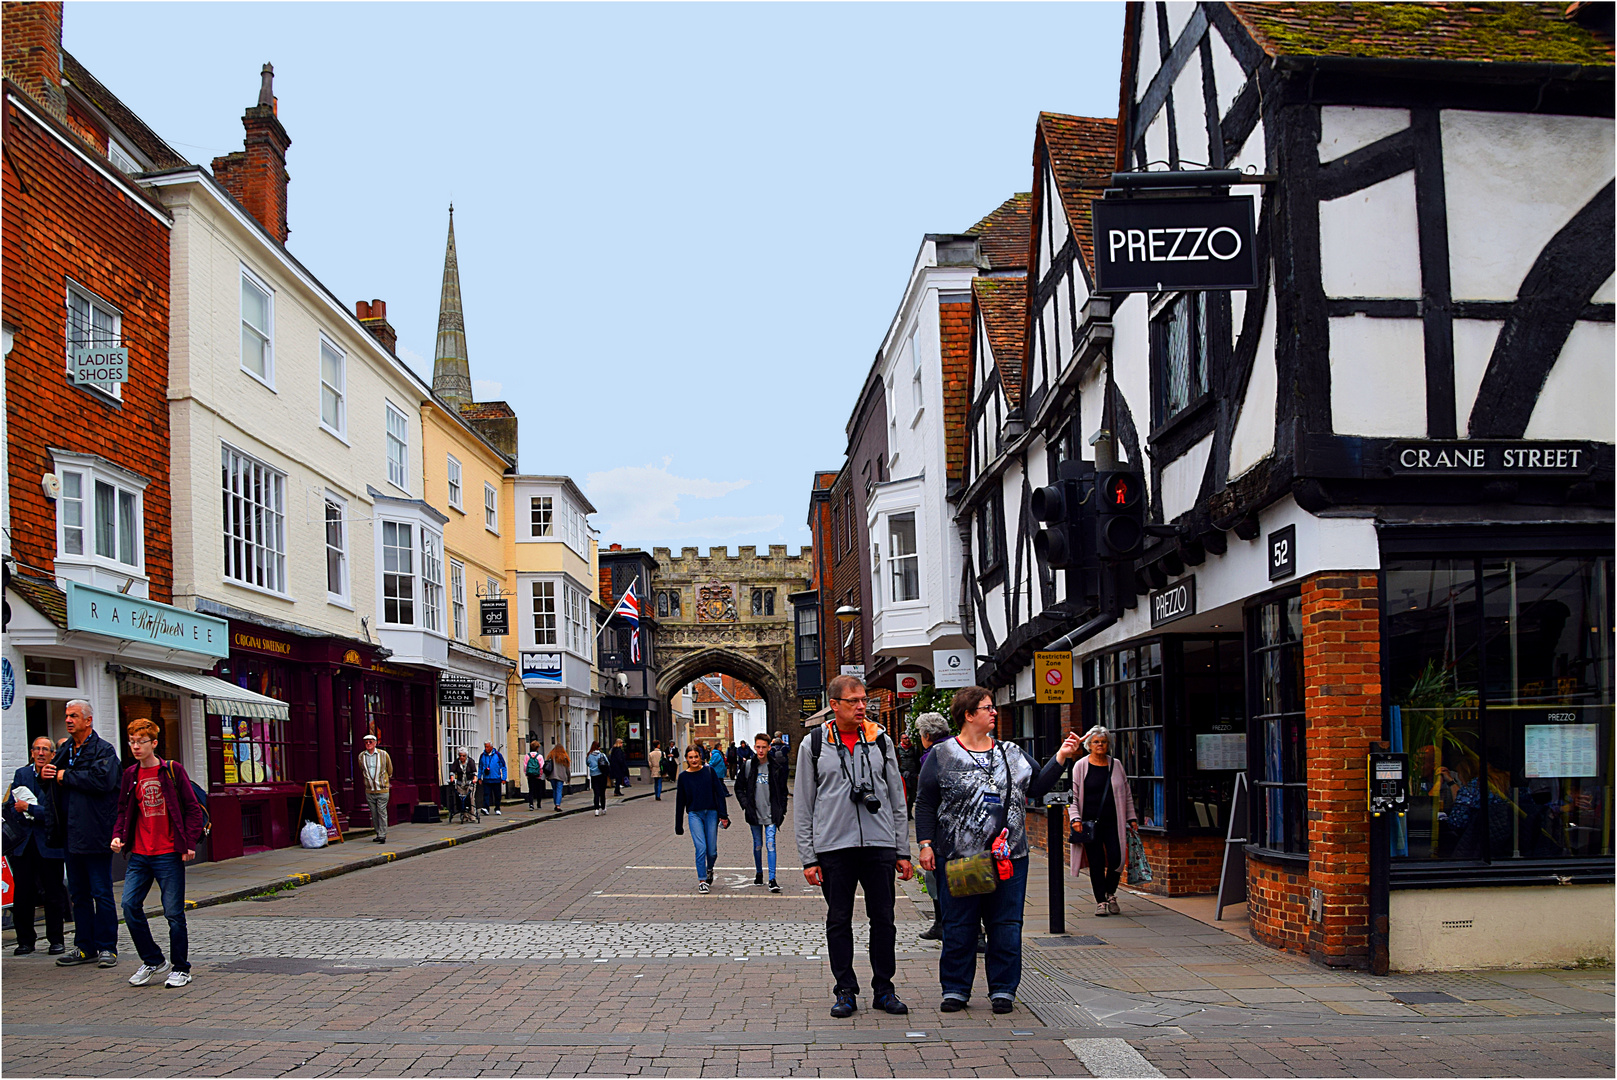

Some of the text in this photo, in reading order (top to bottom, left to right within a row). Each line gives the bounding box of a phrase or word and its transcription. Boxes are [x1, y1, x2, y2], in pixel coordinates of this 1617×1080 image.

[1109, 226, 1242, 262] PREZZO
[78, 353, 124, 366] LADIES
[79, 368, 123, 381] SHOES
[1399, 449, 1582, 468] CRANE STREET
[1274, 539, 1288, 567] 52
[1155, 585, 1187, 621] PREZZO
[485, 611, 502, 624] ghd
[234, 632, 291, 654] ORIGINAL SWEETSHOP
[1547, 712, 1576, 721] PREZZO
